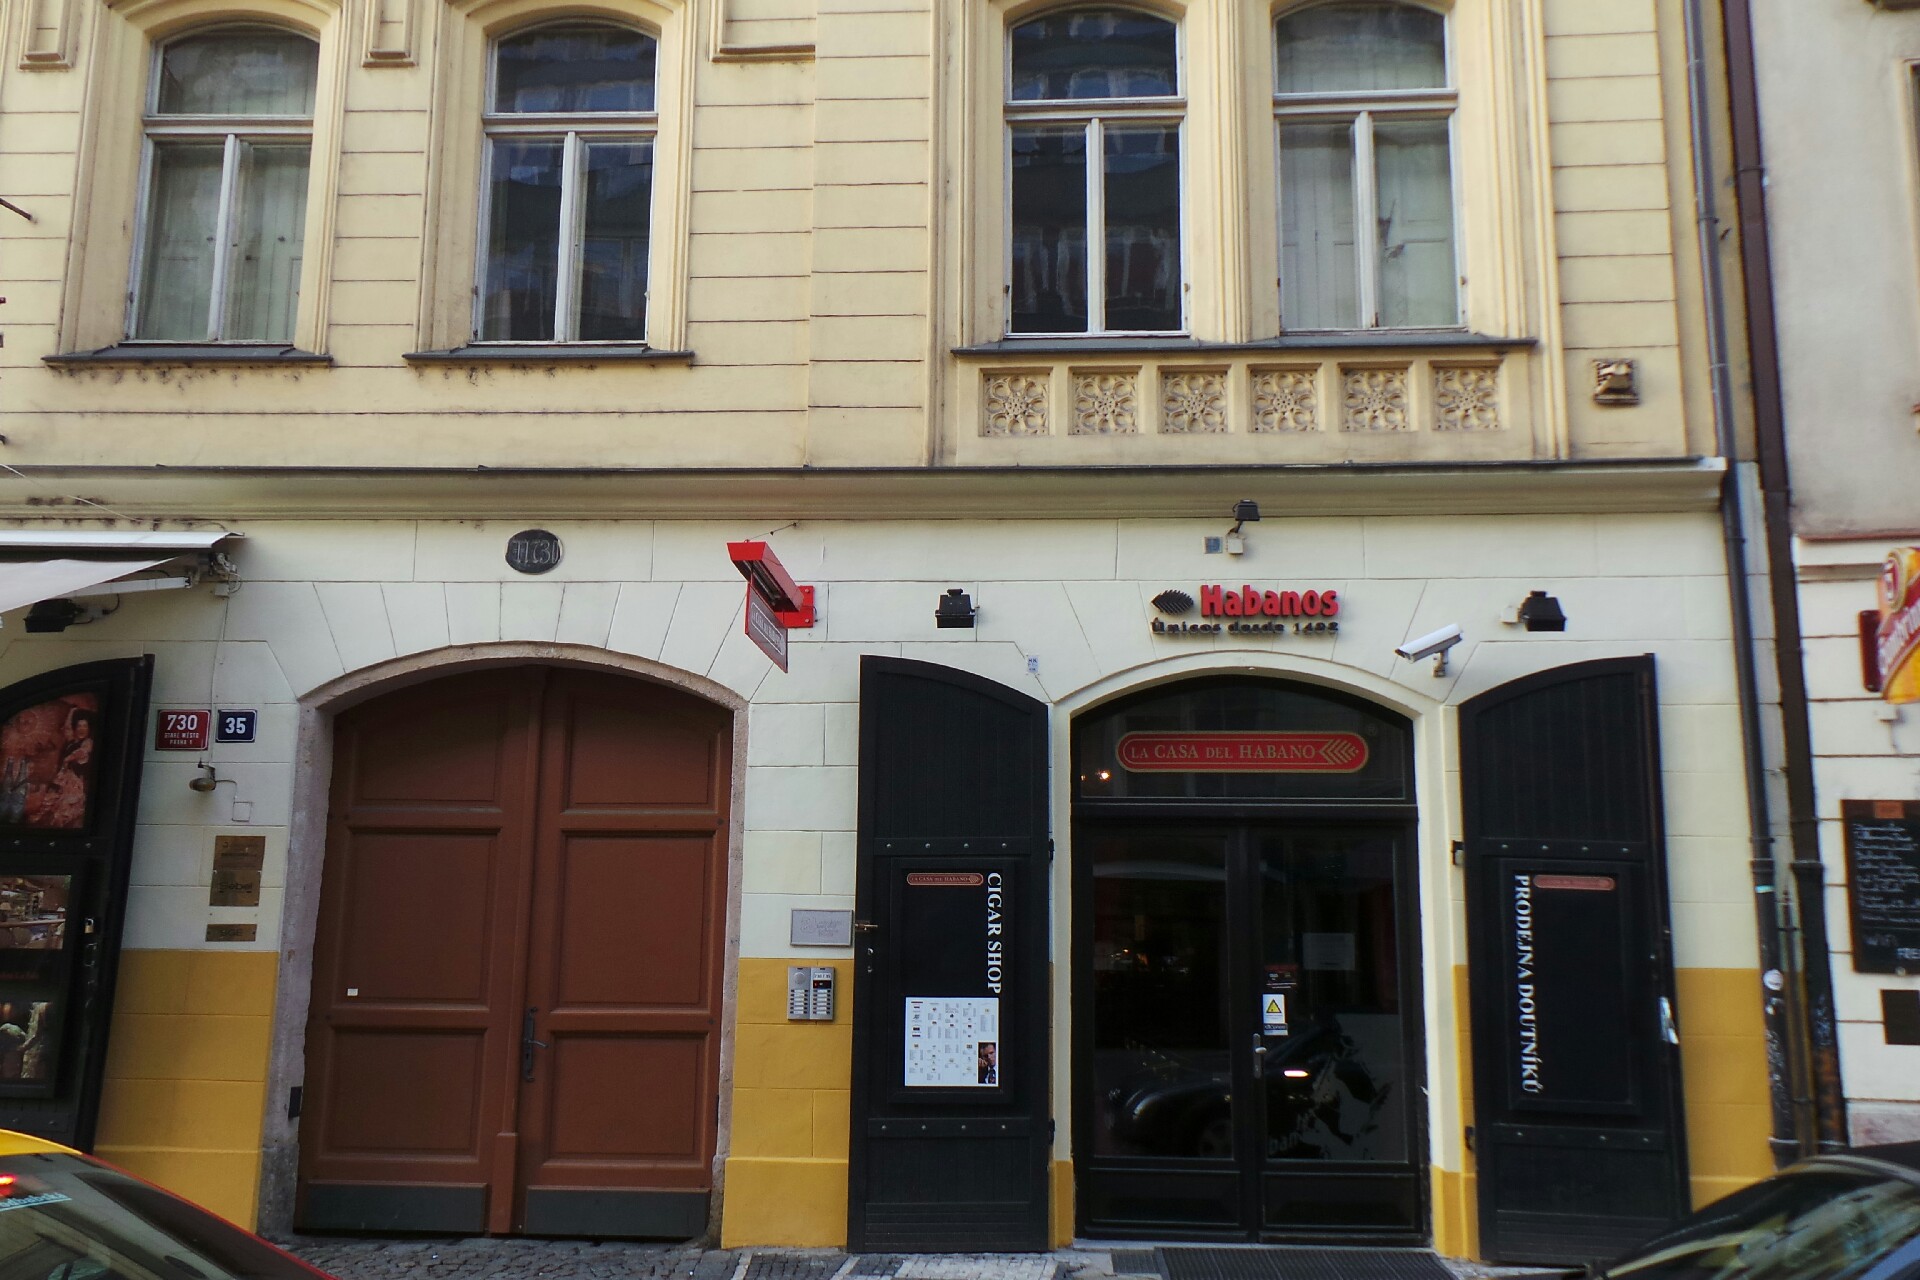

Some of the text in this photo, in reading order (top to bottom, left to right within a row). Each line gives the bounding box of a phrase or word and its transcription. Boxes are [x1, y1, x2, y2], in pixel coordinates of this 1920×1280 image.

[1200, 584, 1340, 617] Habanos
[1150, 617, 1340, 635] Únicos desde 1492
[167, 714, 198, 731] 730
[225, 717, 247, 734] 35
[1131, 744, 1316, 759] LA CASA DEL HABANO
[987, 872, 1002, 994] CIGAR SHOP
[1514, 875, 1544, 1093] PRODEJNA DOUTNÍKŮ
